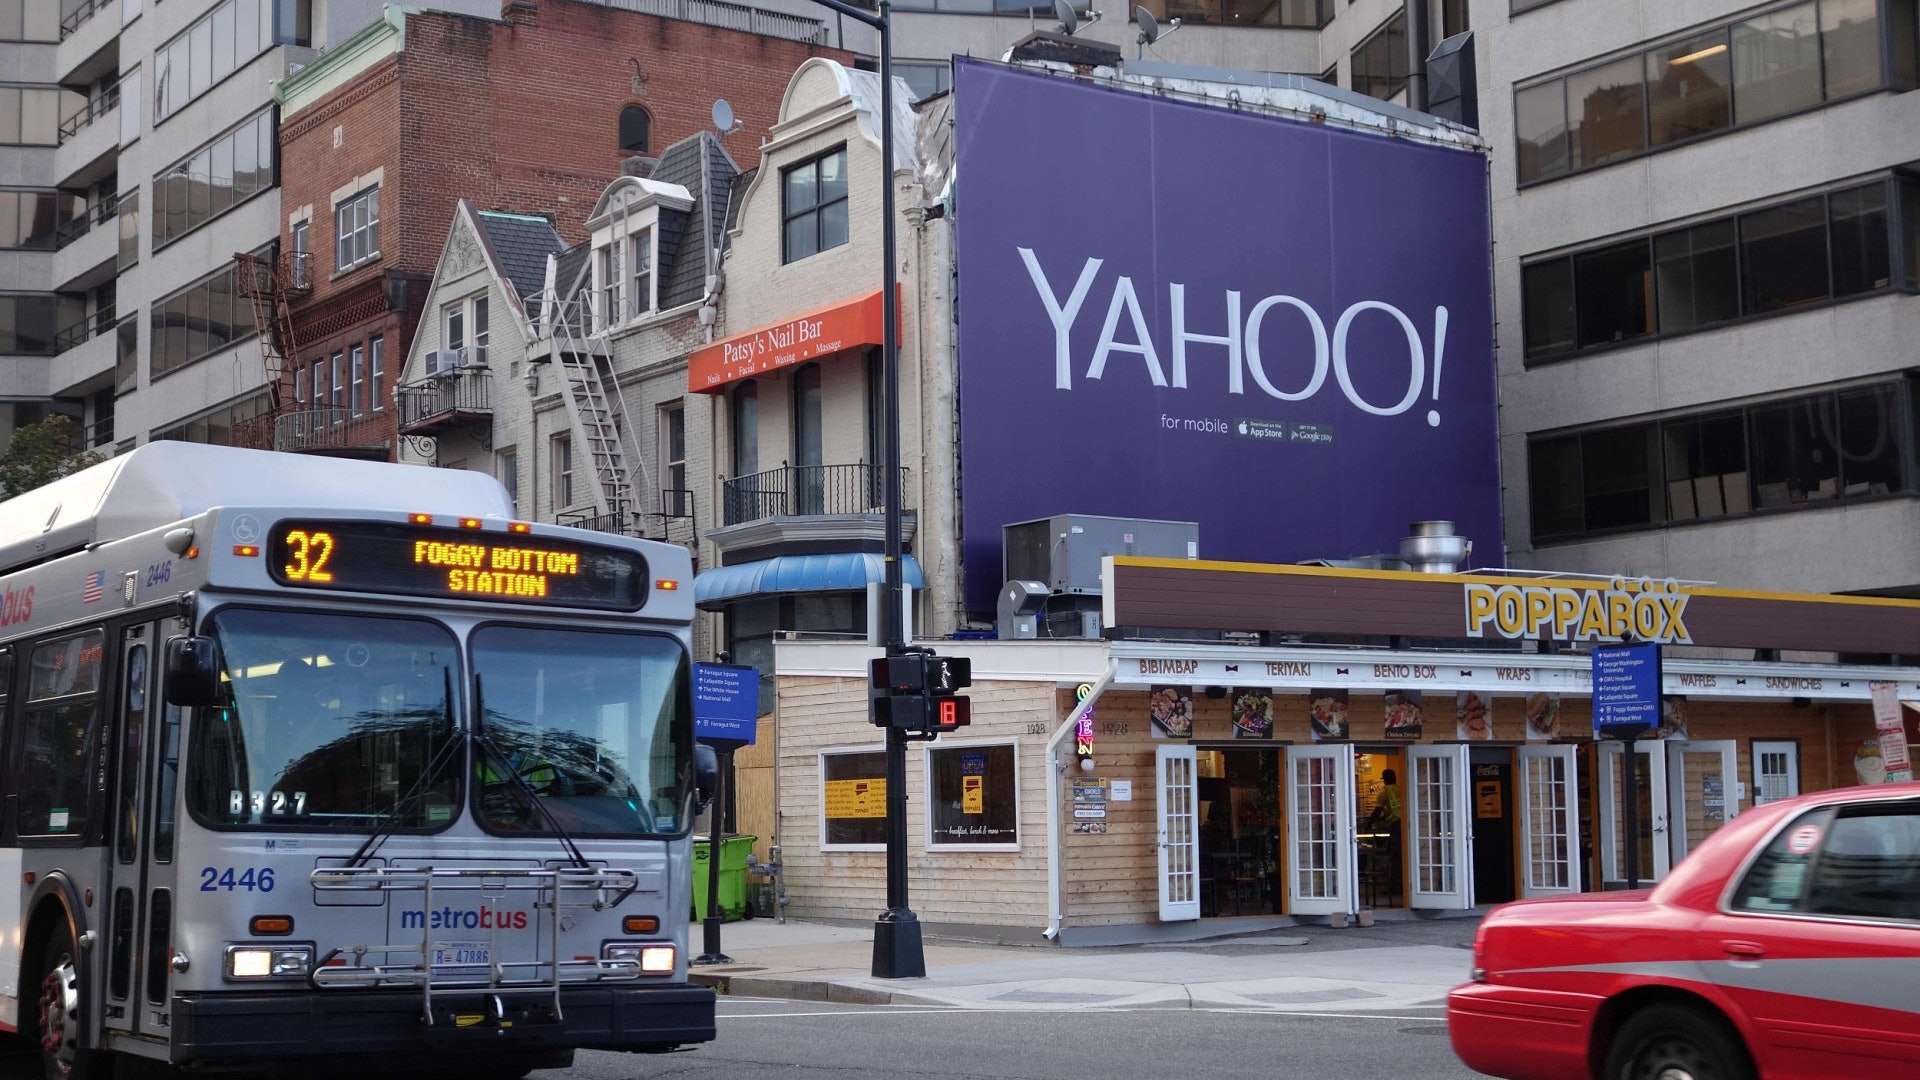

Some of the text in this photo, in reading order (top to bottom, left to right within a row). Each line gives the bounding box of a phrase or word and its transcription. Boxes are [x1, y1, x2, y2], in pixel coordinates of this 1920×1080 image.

[724, 319, 823, 365] Patsy's Nail Bar
[1016, 245, 1449, 428] YAHOO!
[707, 339, 842, 385] Nails Facial Waxing Massage
[1161, 414, 1228, 434] for mobile
[1250, 427, 1283, 438] App Store
[1299, 431, 1333, 443] Google play
[285, 529, 333, 582] 32
[414, 540, 578, 574] FOGGY BOTTOM
[146, 560, 172, 588] 2446
[448, 569, 546, 596] STATION
[0, 581, 35, 628] bus
[1464, 575, 1694, 645] POPPABOX
[1139, 658, 1199, 675] BIBIMBAP
[1265, 661, 1311, 677] TERIYAKI
[1373, 663, 1410, 678] BENTO
[1414, 664, 1437, 680] BOX
[1496, 667, 1532, 682] WRAPS
[1679, 673, 1716, 688] WAFFLES
[1766, 676, 1822, 691] SANDWICHES
[1027, 723, 1046, 735] 1928
[1076, 683, 1094, 755] OEN
[200, 867, 275, 892] 2446
[401, 905, 527, 930] metrobus
